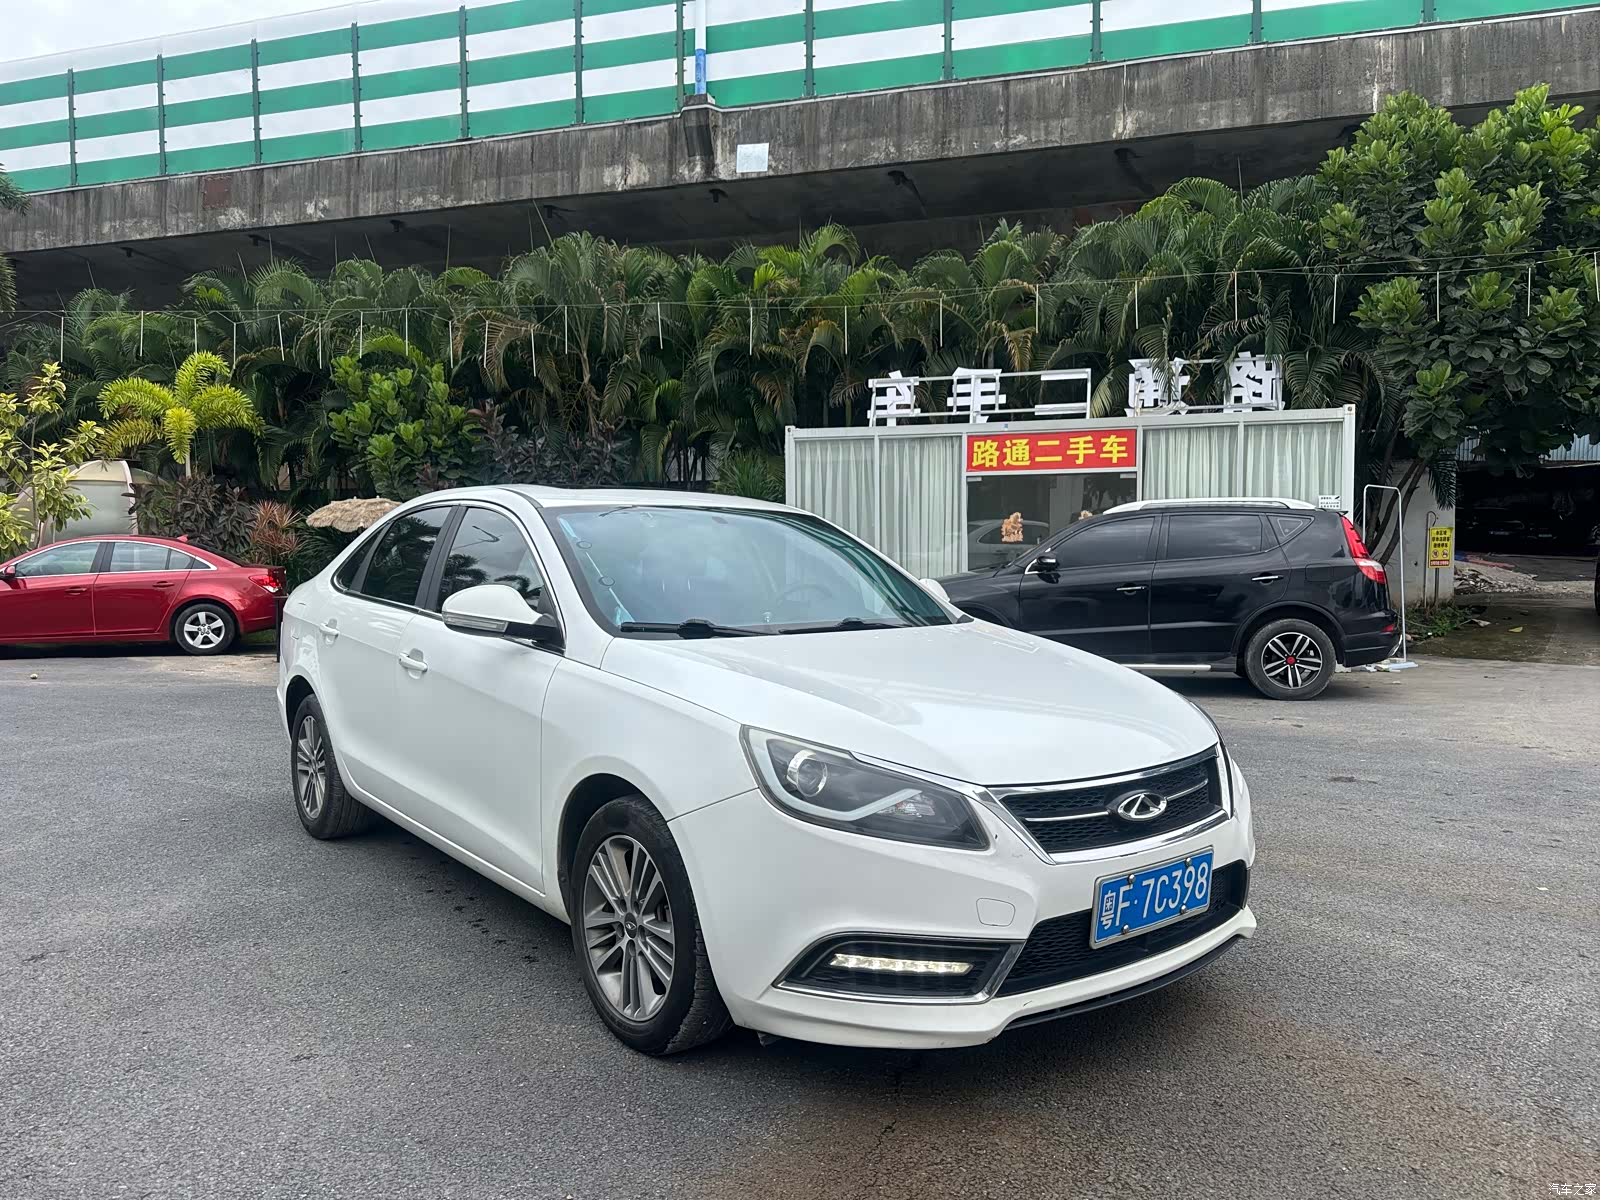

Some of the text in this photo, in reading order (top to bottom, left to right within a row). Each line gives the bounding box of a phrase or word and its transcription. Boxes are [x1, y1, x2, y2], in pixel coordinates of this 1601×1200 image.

[971, 434, 1129, 468] 路通二手车
